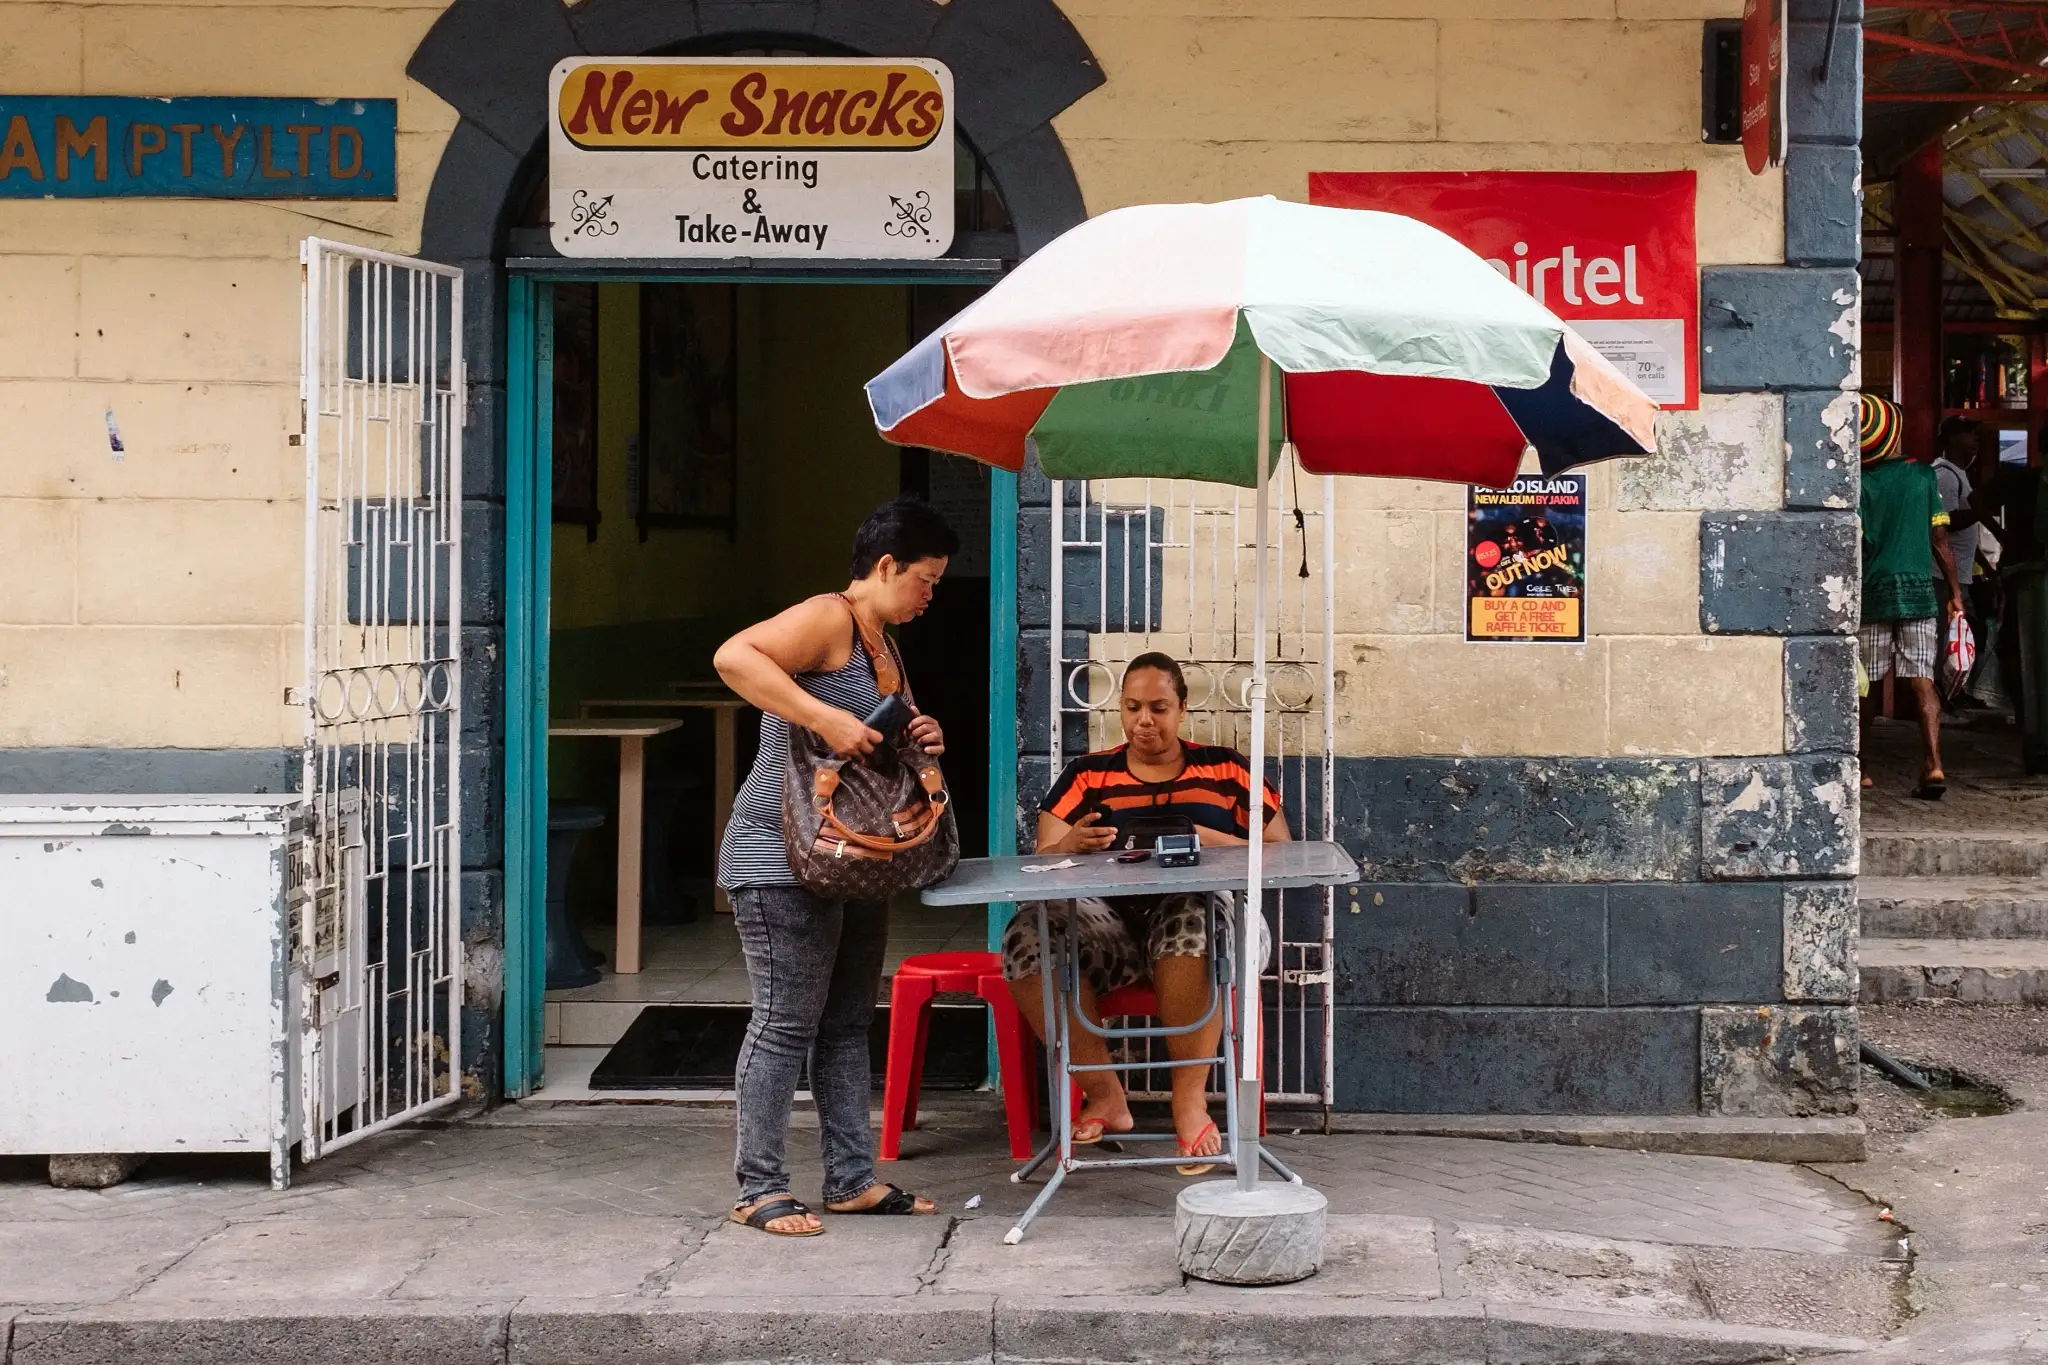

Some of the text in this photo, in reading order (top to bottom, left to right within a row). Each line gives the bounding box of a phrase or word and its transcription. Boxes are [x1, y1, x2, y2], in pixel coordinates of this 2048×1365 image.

[568, 70, 943, 137] New Snacks
[0, 115, 108, 181] AM
[692, 154, 818, 188] Catering
[742, 188, 763, 214] &
[675, 214, 828, 250] Take-Away
[1475, 495, 1579, 505] NEW ALBUM BY JAKIM
[1527, 480, 1578, 494] ISLAND
[1486, 563, 1522, 590] OUT
[1522, 544, 1567, 576] NOW
[1485, 600, 1566, 611] BUY A CD AND
[1495, 612, 1555, 622] GET A FREE
[1486, 623, 1566, 633] RAFFLE TICKET
